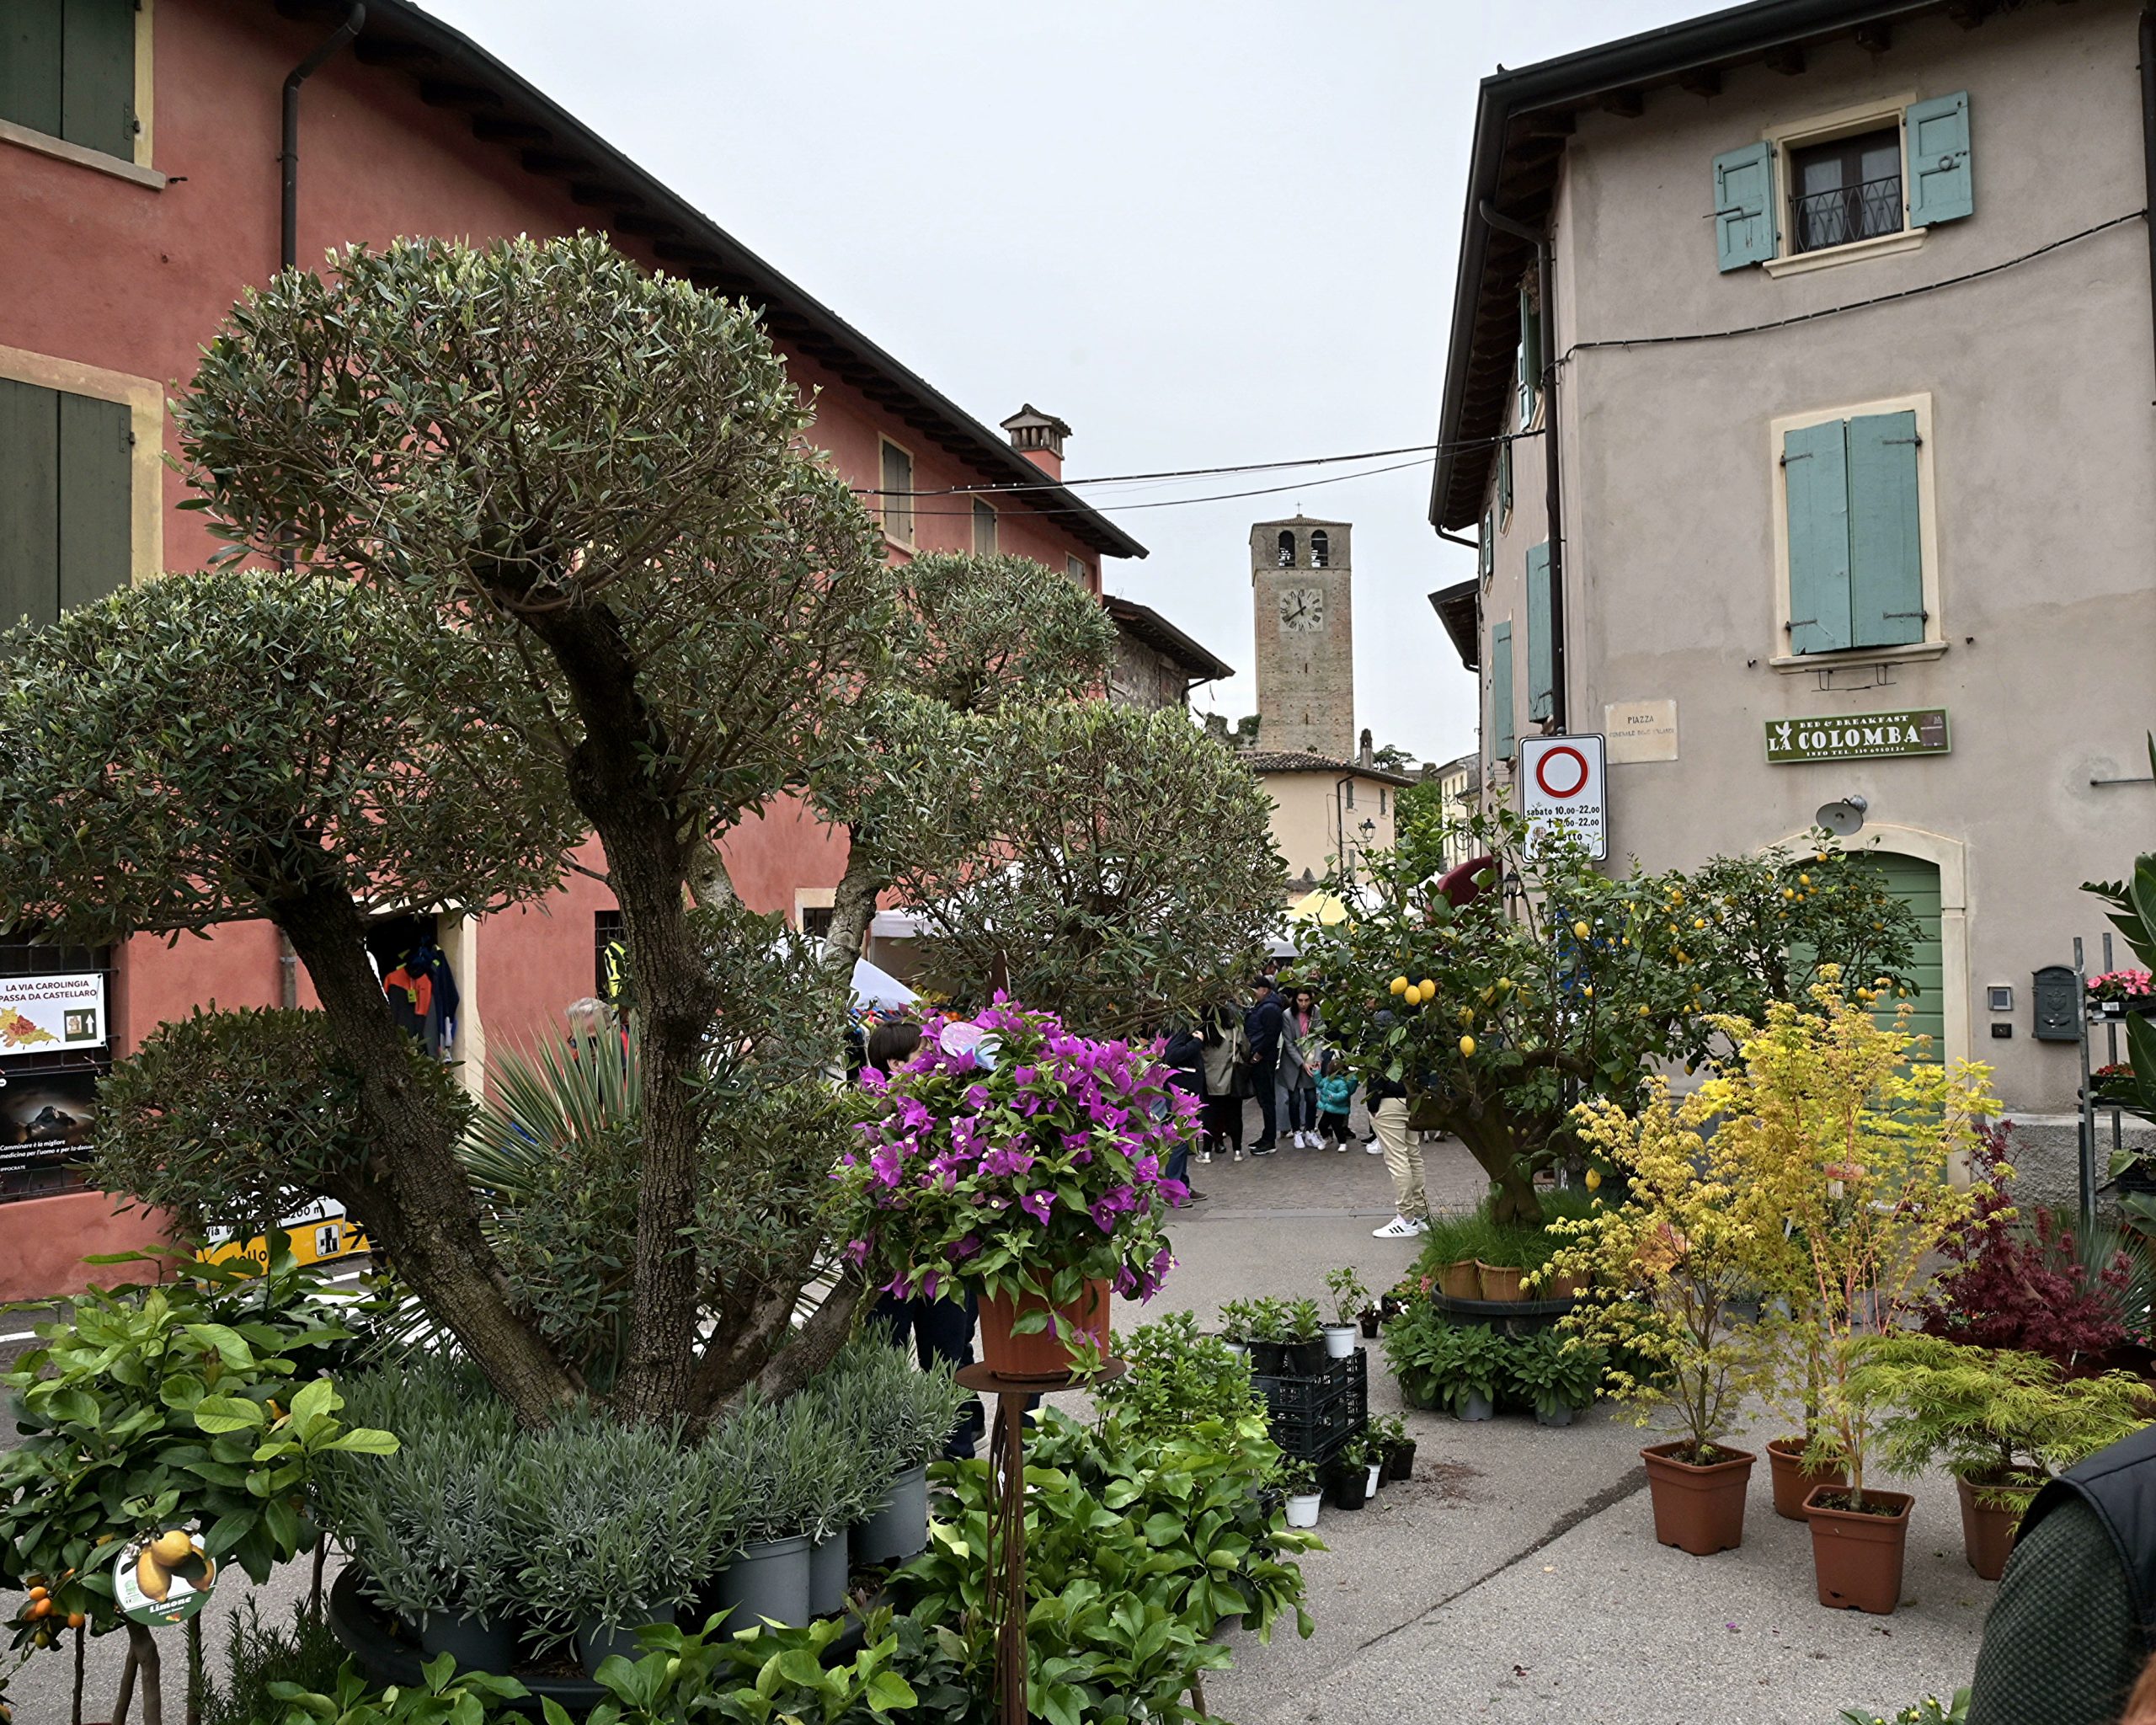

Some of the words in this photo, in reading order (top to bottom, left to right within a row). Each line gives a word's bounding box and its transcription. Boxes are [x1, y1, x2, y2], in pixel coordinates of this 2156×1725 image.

[1627, 715, 1654, 724] PIAZZA
[1836, 715, 1909, 726] BREAKFAST
[1768, 734, 1793, 751] LA
[1798, 724, 1921, 750] COLOMBA
[1526, 808, 1553, 816] sabato
[35, 980, 89, 990] CAROLINGIA
[43, 989, 97, 1000] CASTELLARO
[0, 1143, 32, 1151] Camminare
[149, 1596, 192, 1613] Limone
